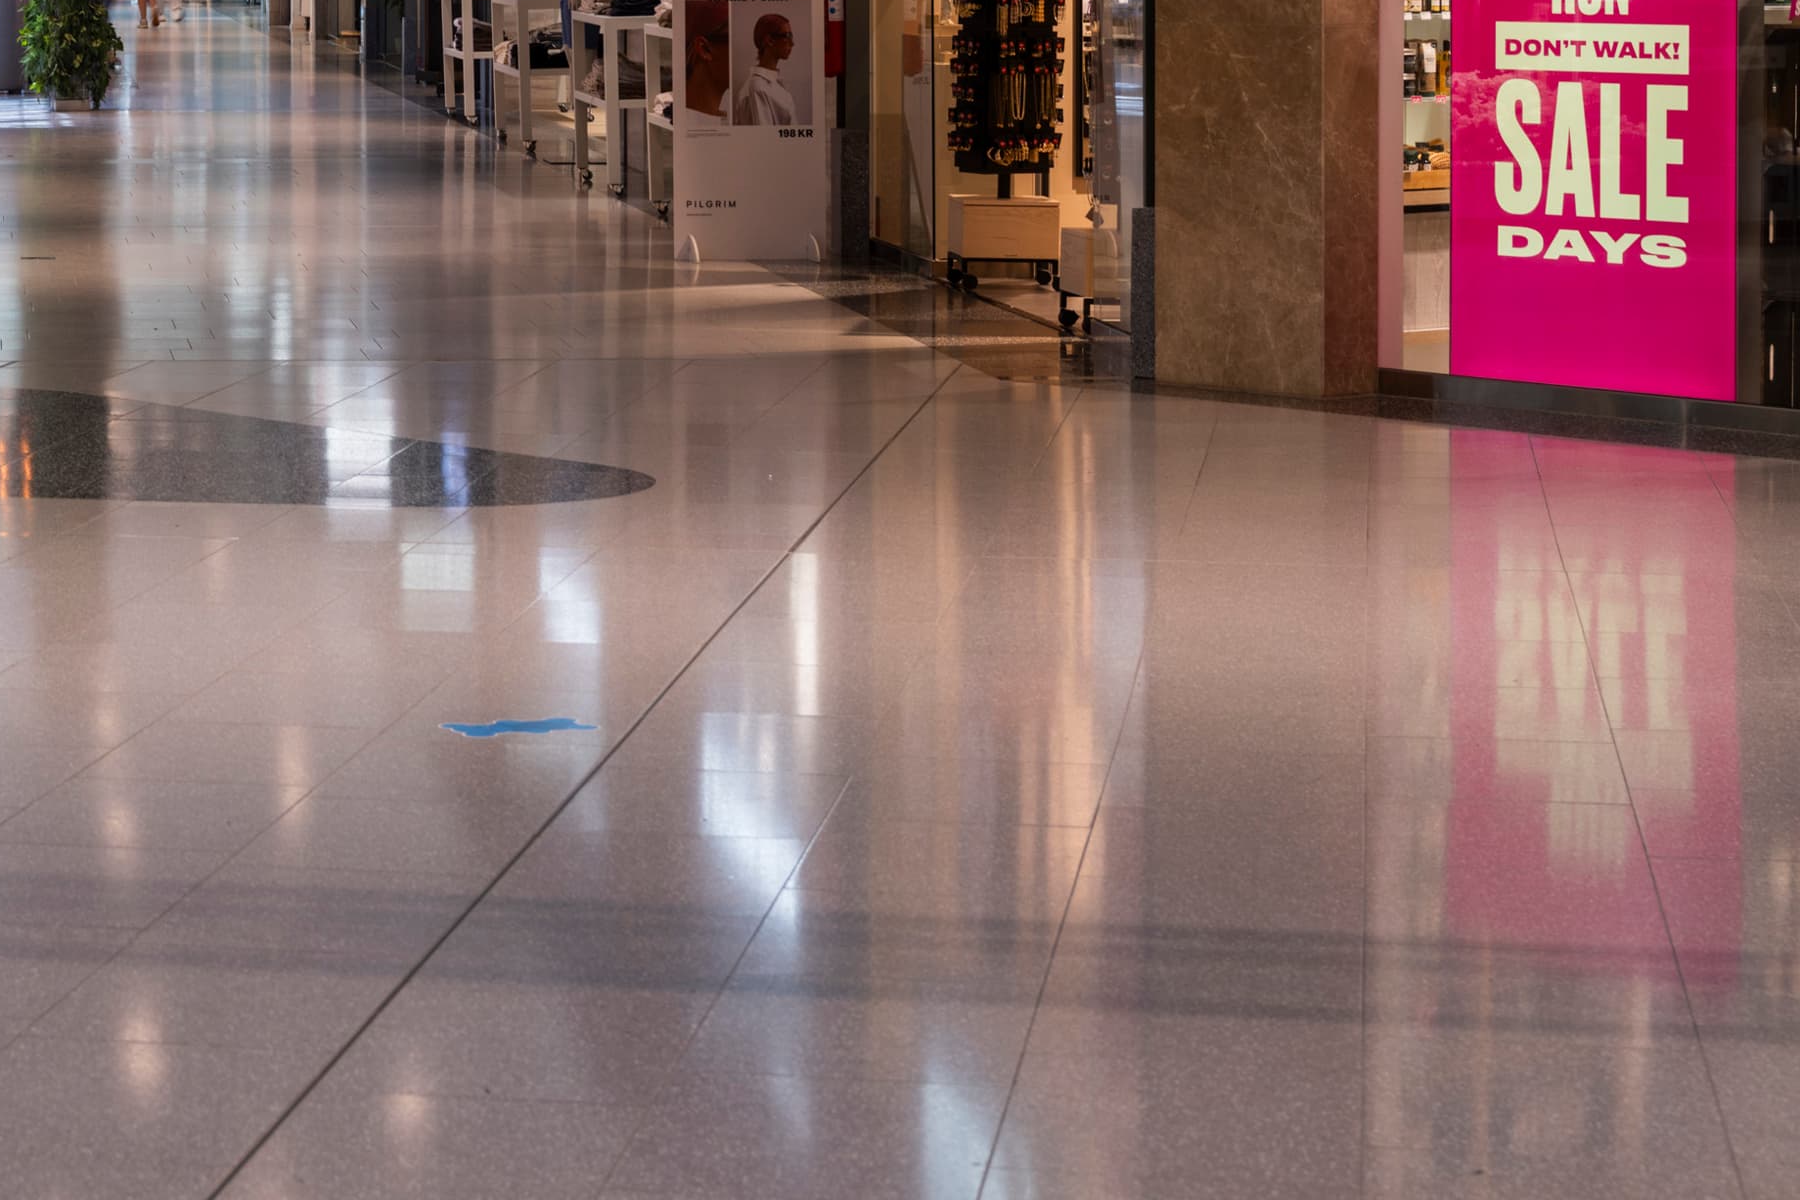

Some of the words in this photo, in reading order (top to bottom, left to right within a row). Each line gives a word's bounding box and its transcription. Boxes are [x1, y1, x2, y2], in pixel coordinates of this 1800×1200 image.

[1504, 37, 1587, 58] DON'T
[1593, 40, 1680, 61] WALK!
[778, 129, 796, 138] 198
[798, 129, 814, 138] KR
[1494, 78, 1689, 224] SALE
[685, 200, 737, 208] PILGRIM
[1496, 224, 1688, 268] DAYS
